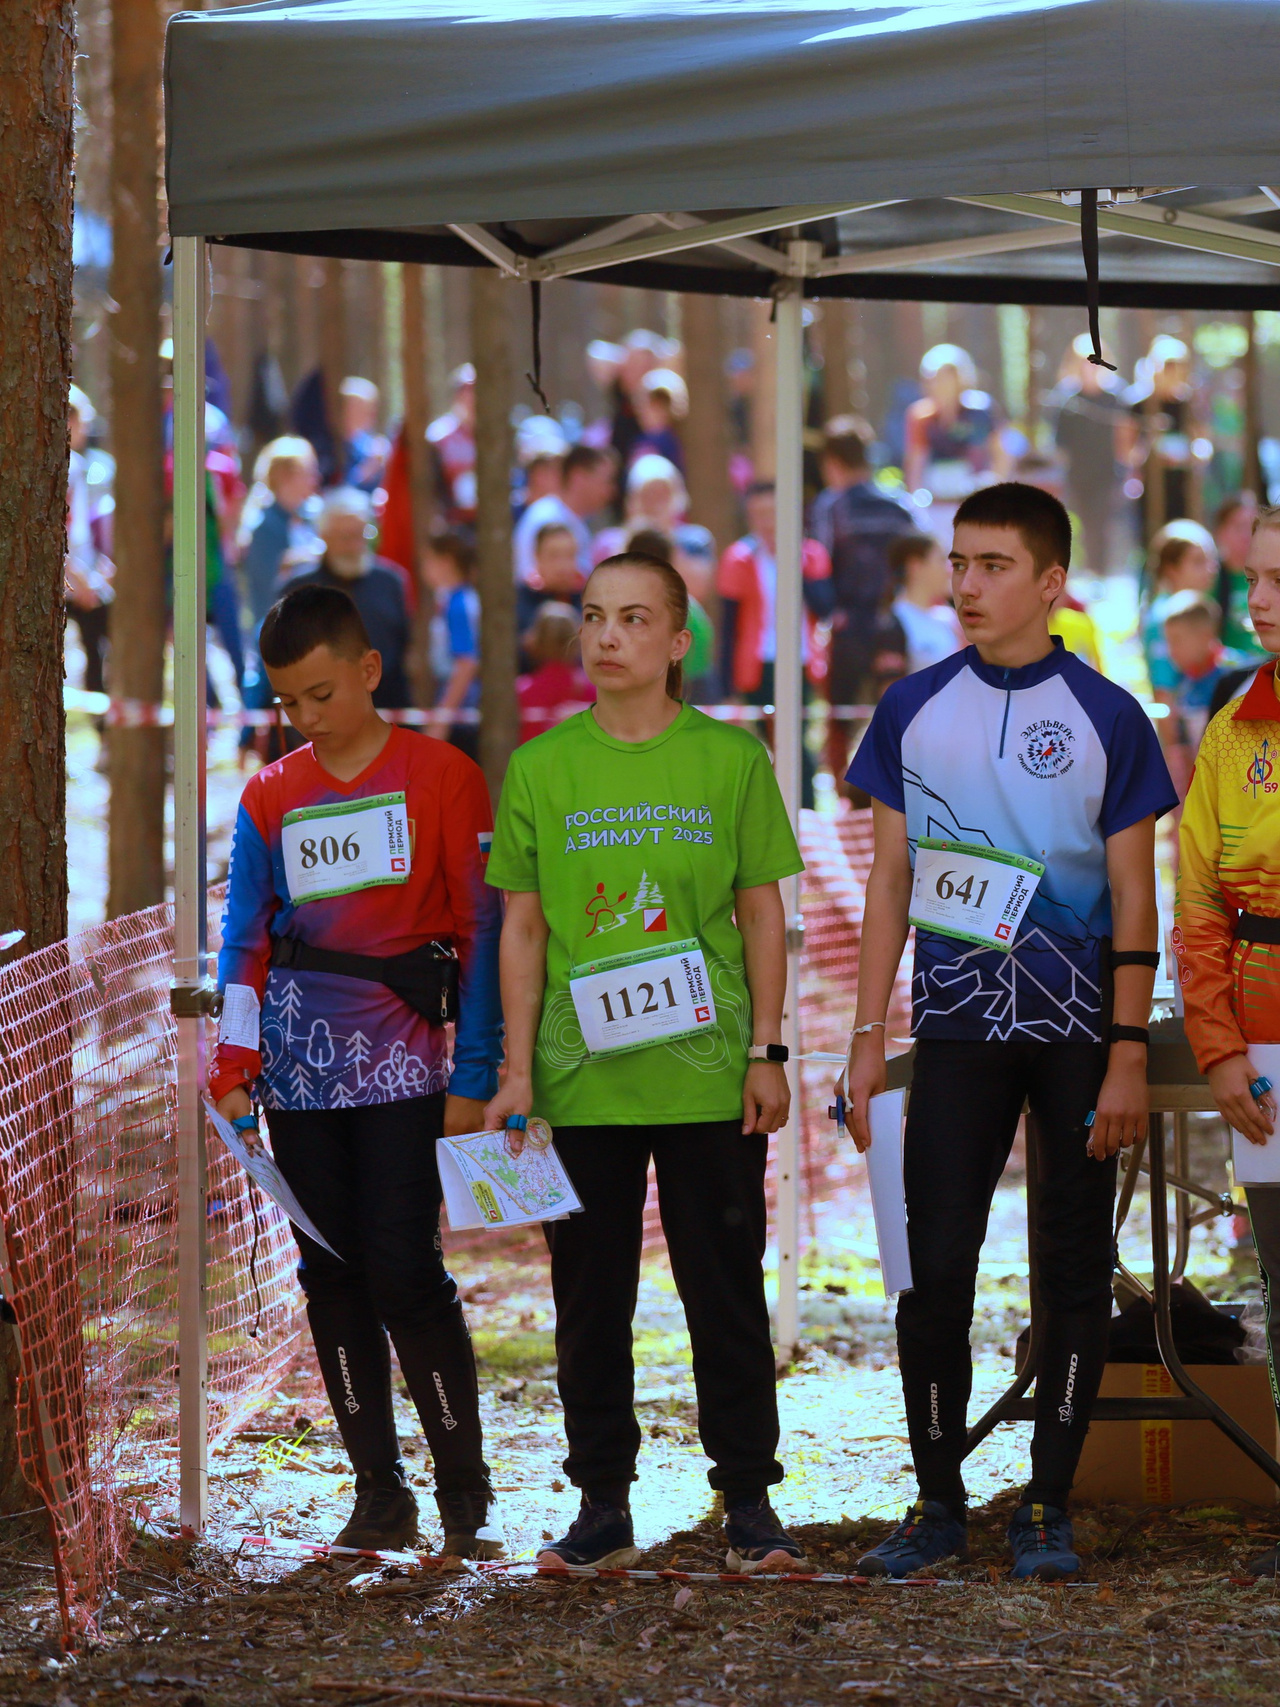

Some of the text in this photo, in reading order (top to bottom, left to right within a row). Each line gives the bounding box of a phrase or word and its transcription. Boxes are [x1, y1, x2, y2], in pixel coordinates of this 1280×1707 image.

[1020, 720, 1075, 742] ЭДЕЛЬВЕЙС
[1264, 782, 1279, 793] 59
[385, 810, 396, 855] ПЕРМСКИЙ
[564, 802, 713, 831] РОССИЙСКИЙ
[300, 831, 360, 869] 806
[395, 819, 404, 854] ПЕРИОД
[564, 826, 713, 855] АЗИМУТ 2025
[936, 870, 989, 909] 641
[1001, 874, 1025, 920] ПЕРМСКИЙ
[1008, 888, 1029, 923] ПЕРИОД
[598, 977, 680, 1023] 1121
[680, 957, 699, 1005] ПЕРМСКИЙ
[693, 966, 707, 1003] ПЕРИОД
[338, 1346, 354, 1396] NORD
[1065, 1353, 1079, 1405] NORD
[432, 1371, 451, 1415] NORD
[930, 1382, 939, 1425] NORD
